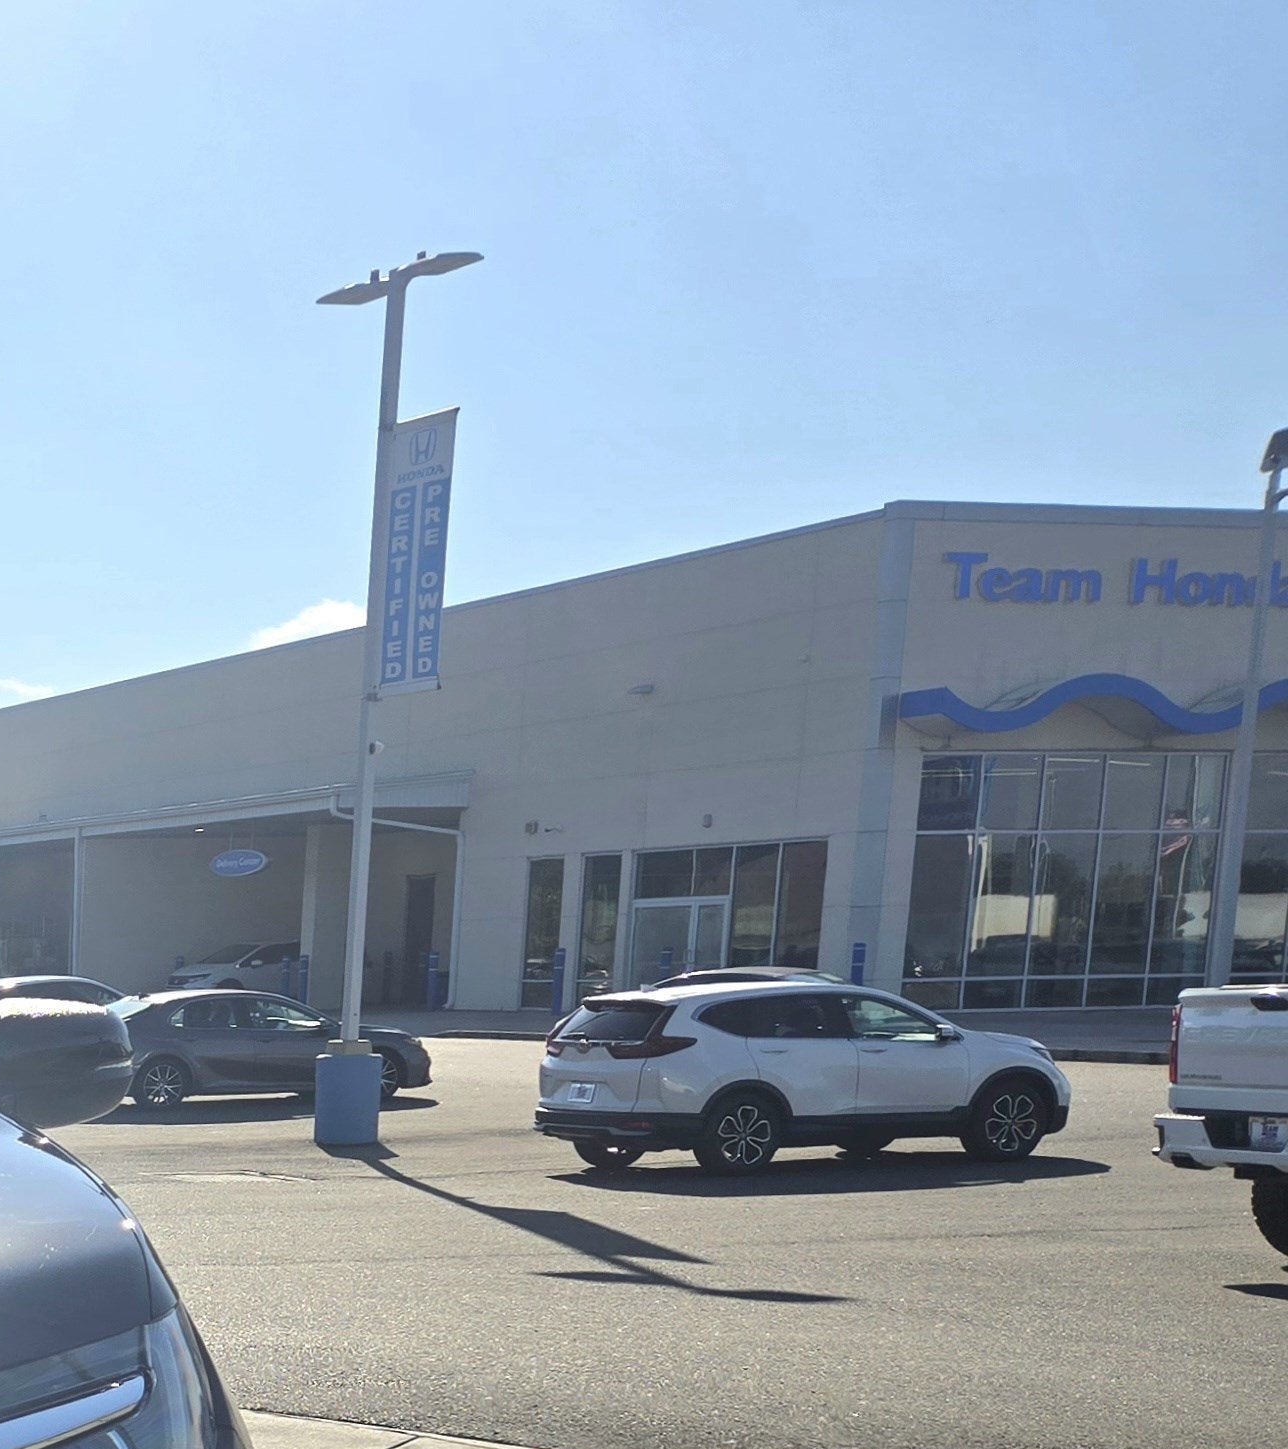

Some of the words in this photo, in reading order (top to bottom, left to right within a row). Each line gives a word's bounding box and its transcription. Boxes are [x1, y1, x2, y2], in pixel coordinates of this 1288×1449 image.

[425, 484, 442, 547] PRE
[384, 492, 412, 680] CERTIFIED
[944, 551, 1103, 602] Team
[1129, 557, 1288, 607] Hond
[417, 571, 440, 674] OWNED
